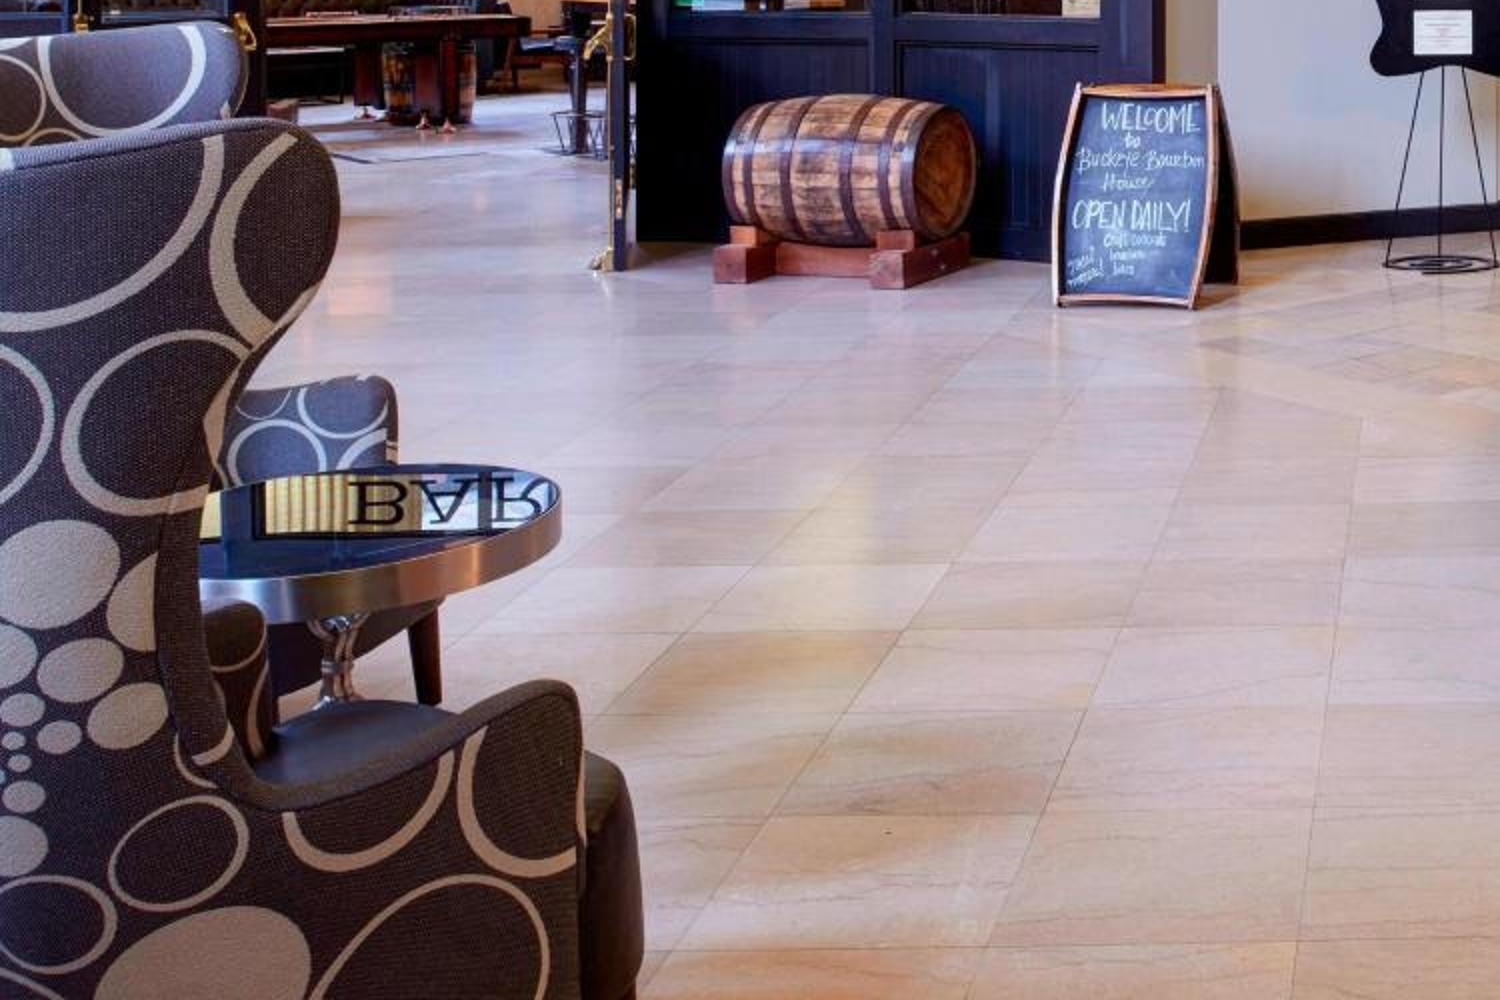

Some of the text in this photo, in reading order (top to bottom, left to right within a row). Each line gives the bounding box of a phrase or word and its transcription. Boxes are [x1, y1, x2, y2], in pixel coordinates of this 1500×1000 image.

[1101, 102, 1201, 135] WELCOME
[1124, 131, 1141, 148] to
[1075, 148, 1139, 175] Buckeye
[1072, 199, 1191, 232] OPEN DAILY!
